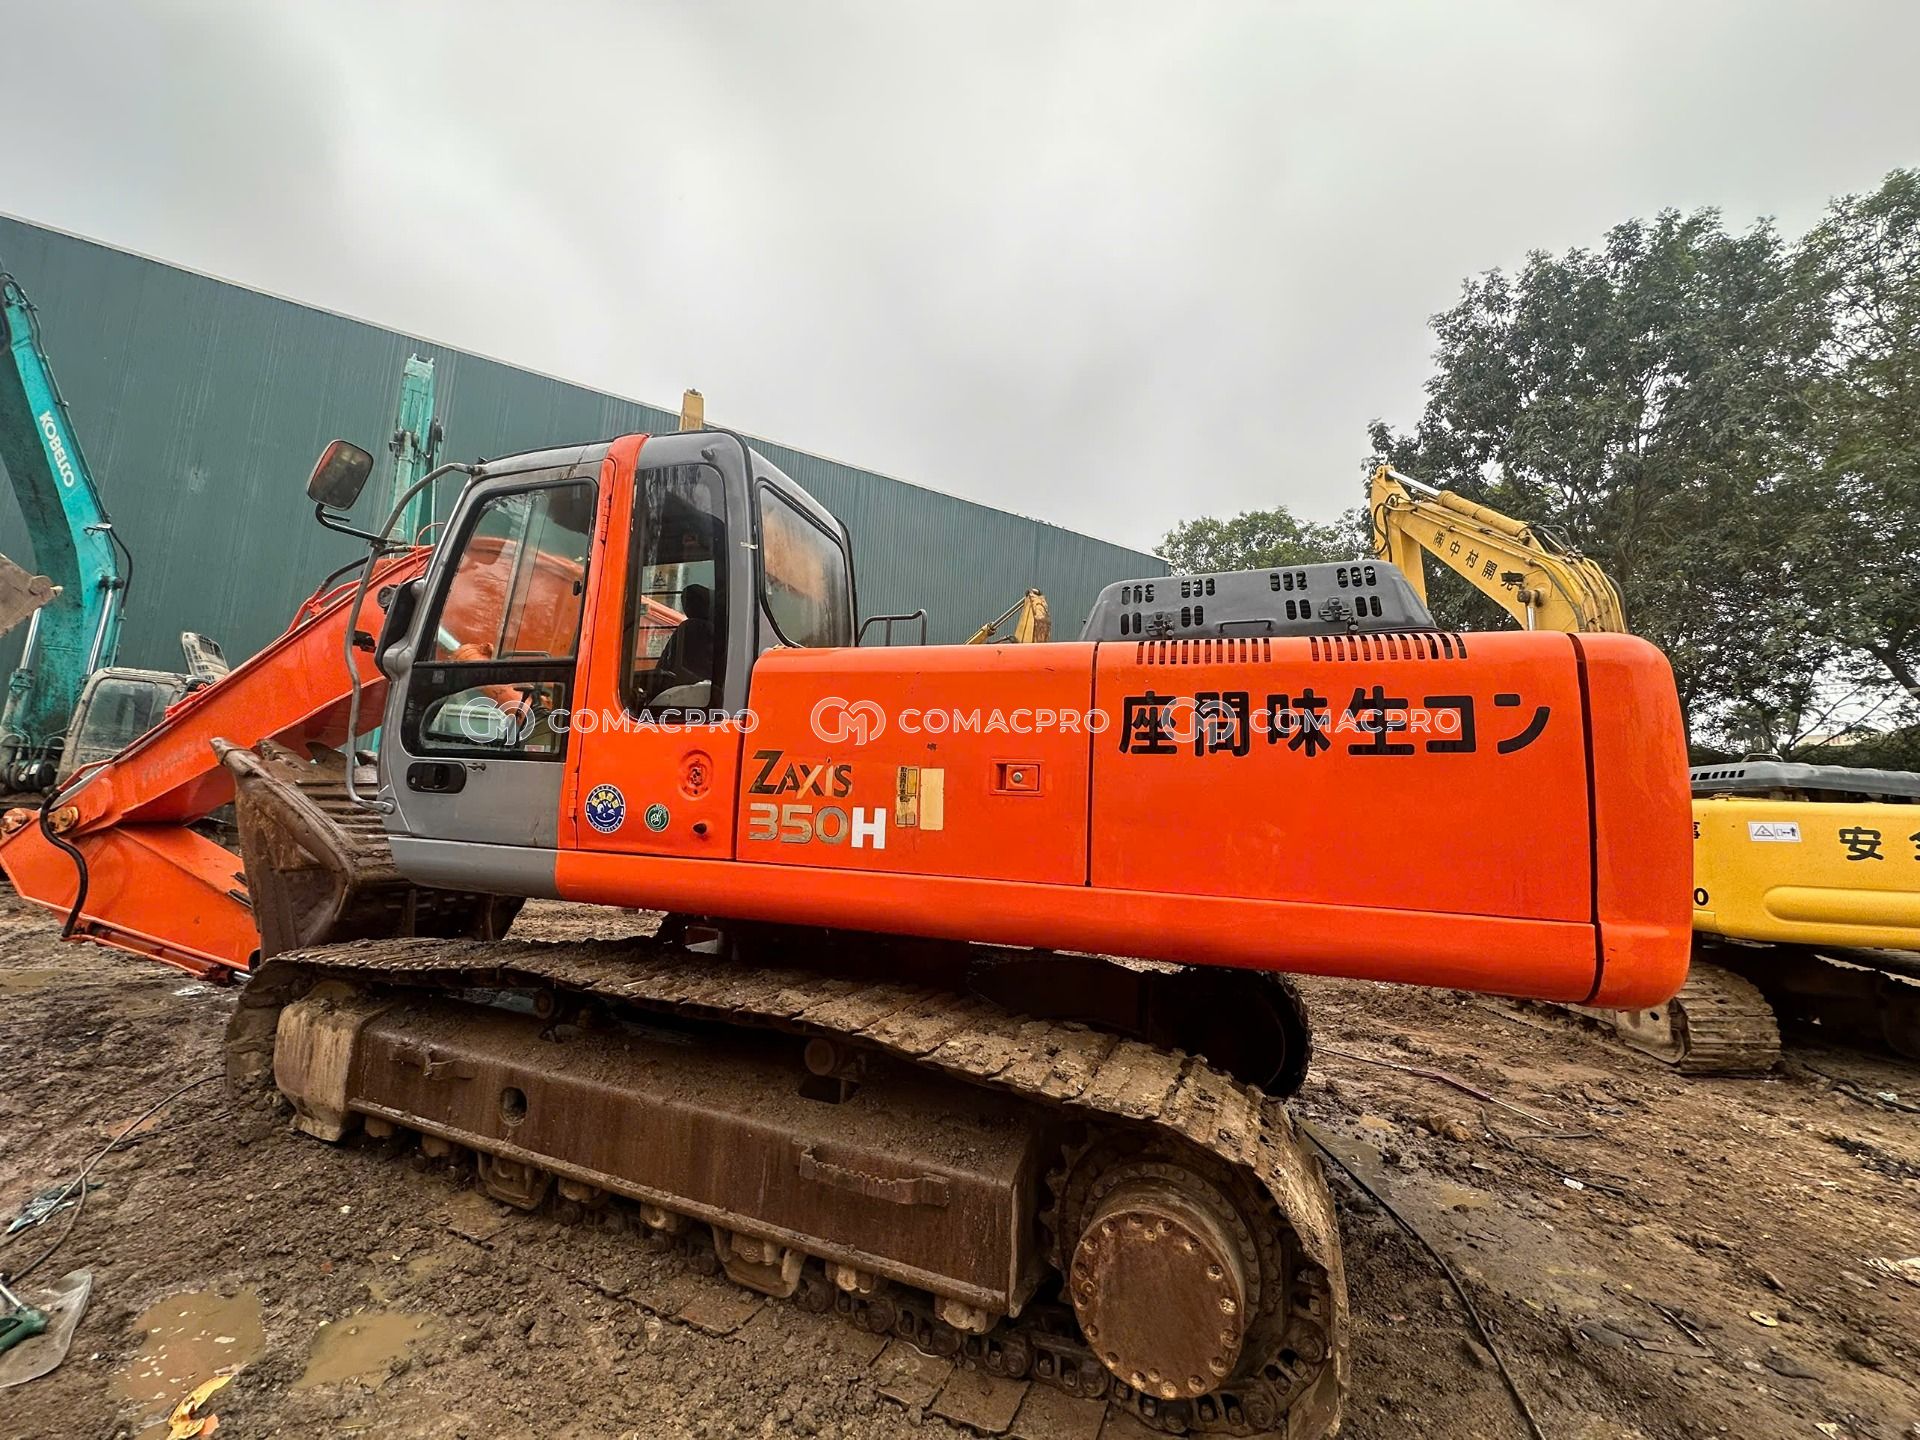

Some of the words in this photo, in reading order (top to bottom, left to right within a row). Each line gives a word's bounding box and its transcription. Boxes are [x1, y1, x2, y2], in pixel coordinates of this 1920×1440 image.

[39, 410, 75, 488] KOBELCO
[1118, 686, 1551, 757] 座間味生コン
[748, 803, 887, 850] 350H
[1838, 826, 1920, 861] 安
